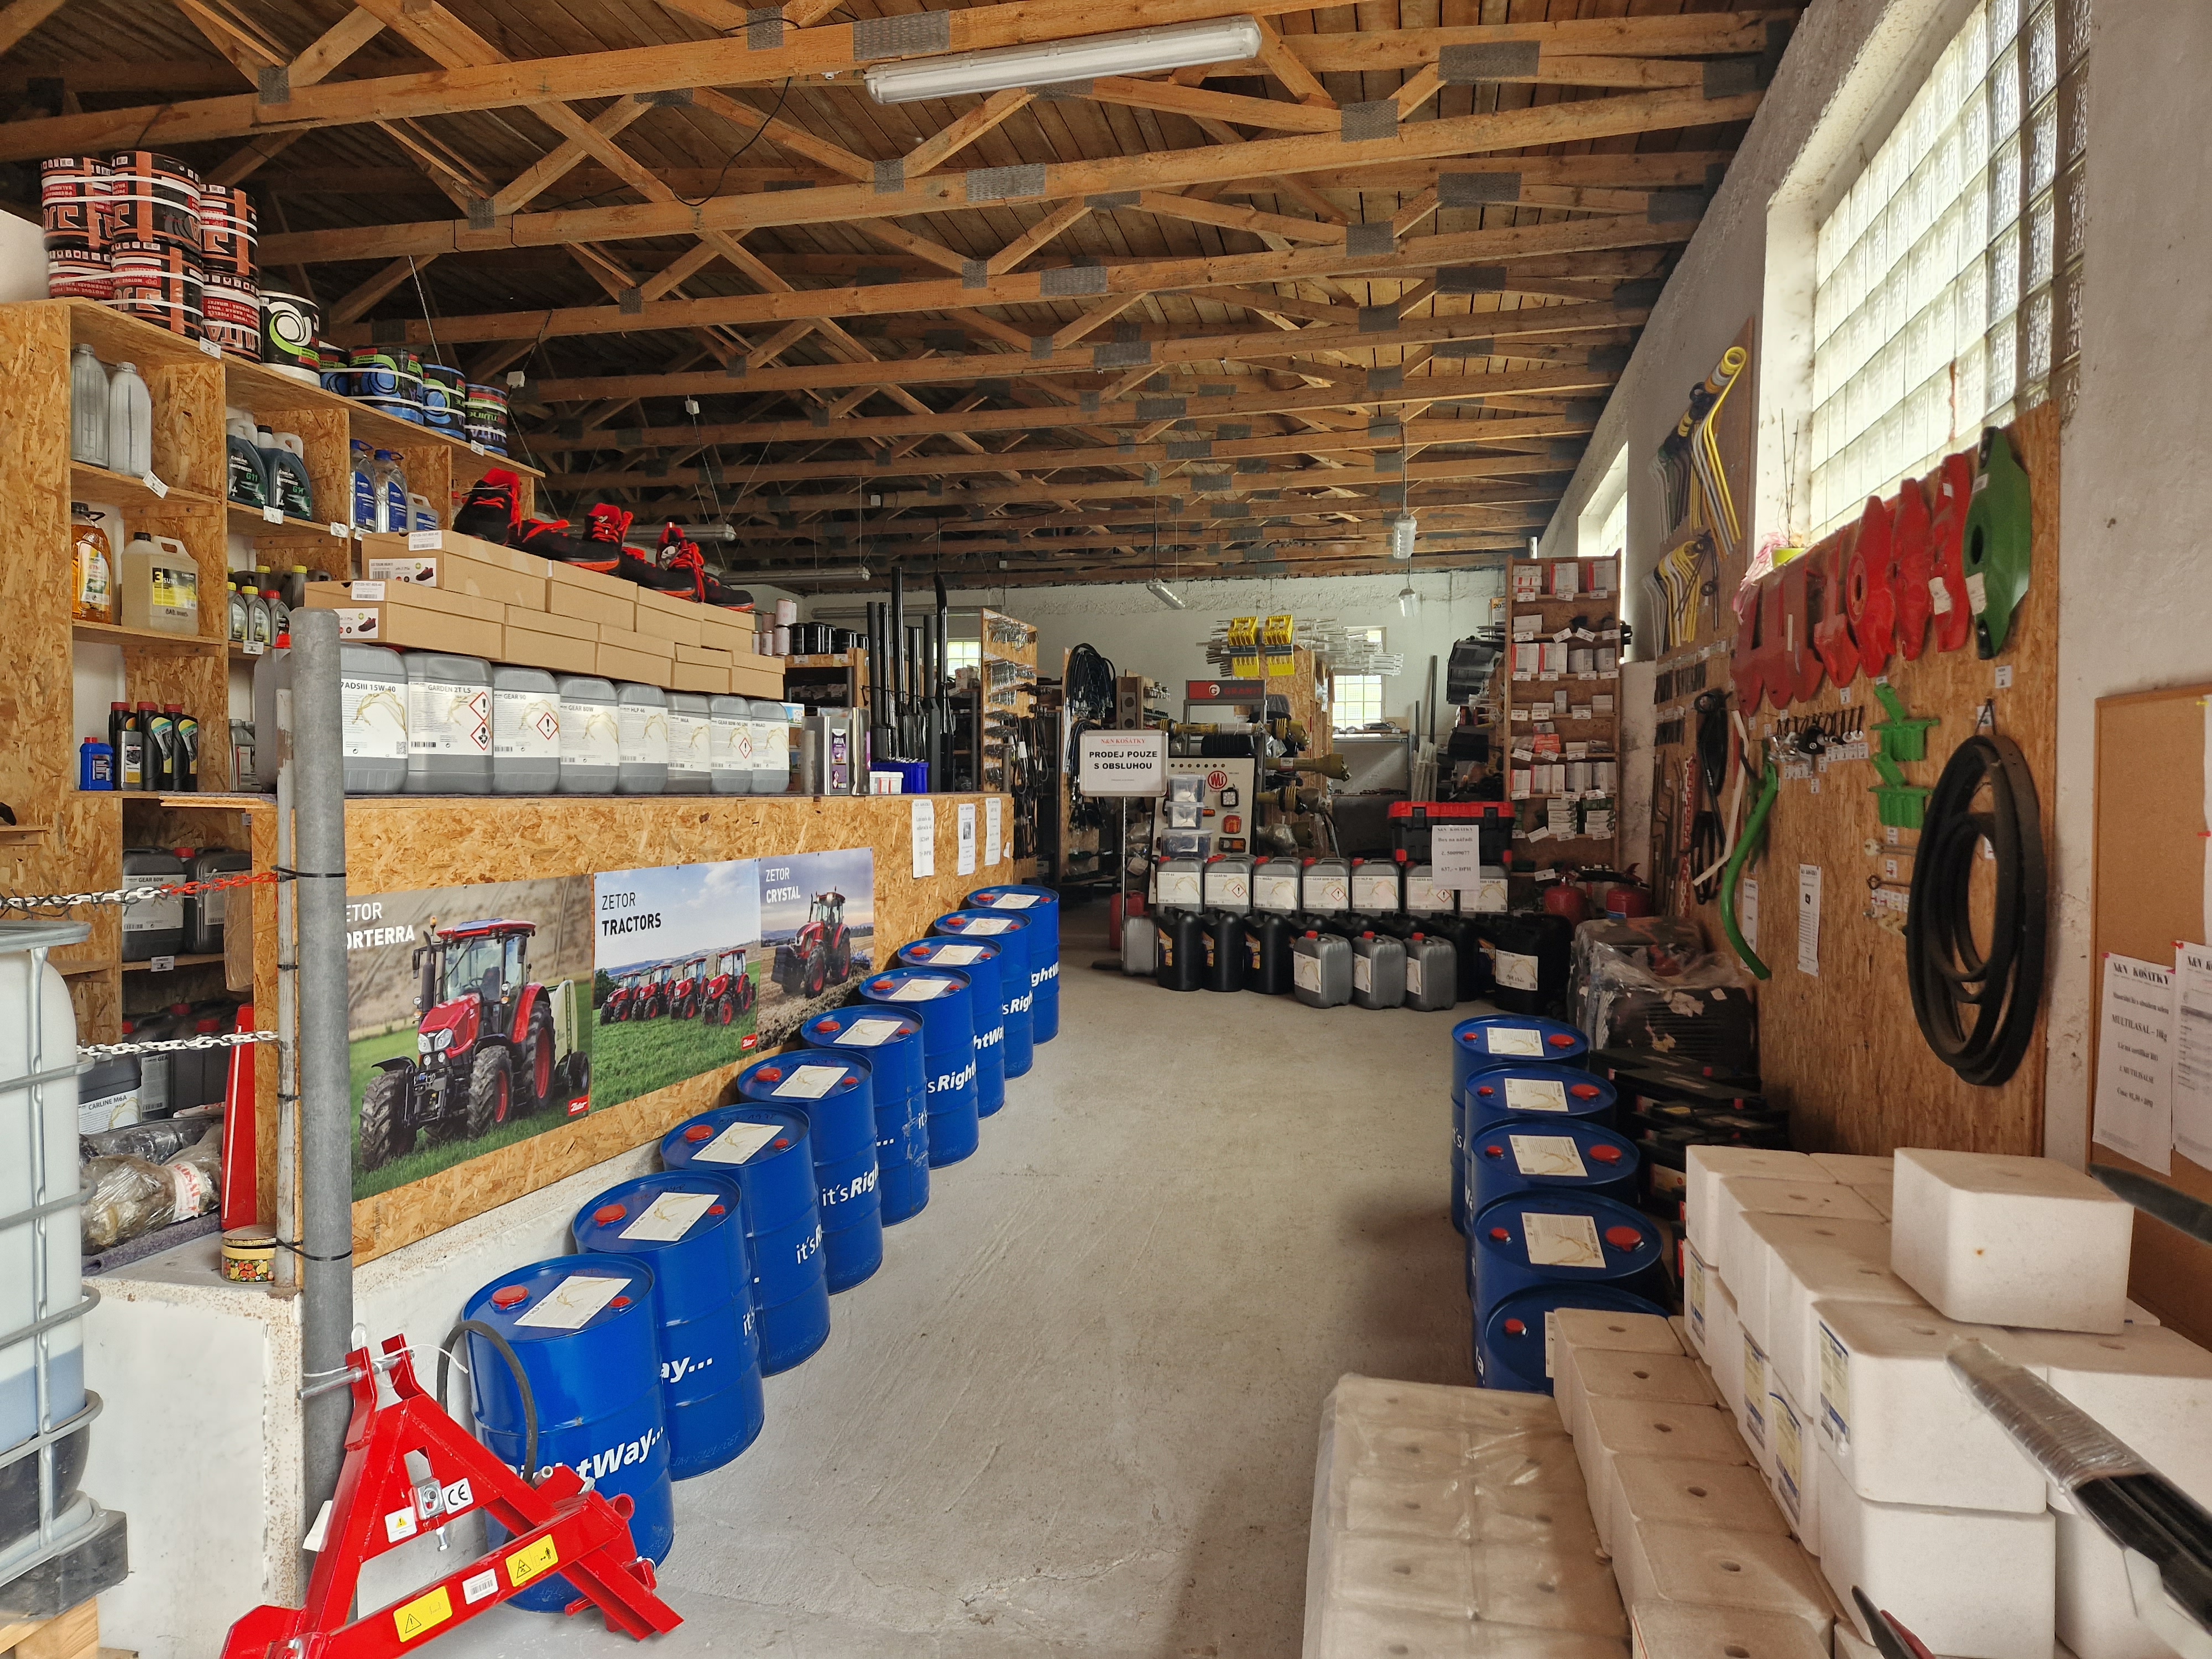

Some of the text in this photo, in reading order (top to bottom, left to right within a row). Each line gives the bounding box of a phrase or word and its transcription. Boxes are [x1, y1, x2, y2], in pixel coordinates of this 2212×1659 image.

[246, 472, 259, 482] G11
[154, 571, 163, 583] 3
[370, 684, 396, 692] 15W-40
[1223, 687, 1262, 695] GRANIT
[765, 867, 790, 882] ZETOR
[602, 892, 636, 911] ZETOR
[766, 885, 801, 904] CRYSTAL
[346, 902, 383, 922] ETOR
[602, 912, 661, 936] TRACTORS
[347, 925, 415, 950] ORTERRA
[88, 1094, 127, 1110] CARLINE M6A
[447, 1483, 469, 1506] CE
